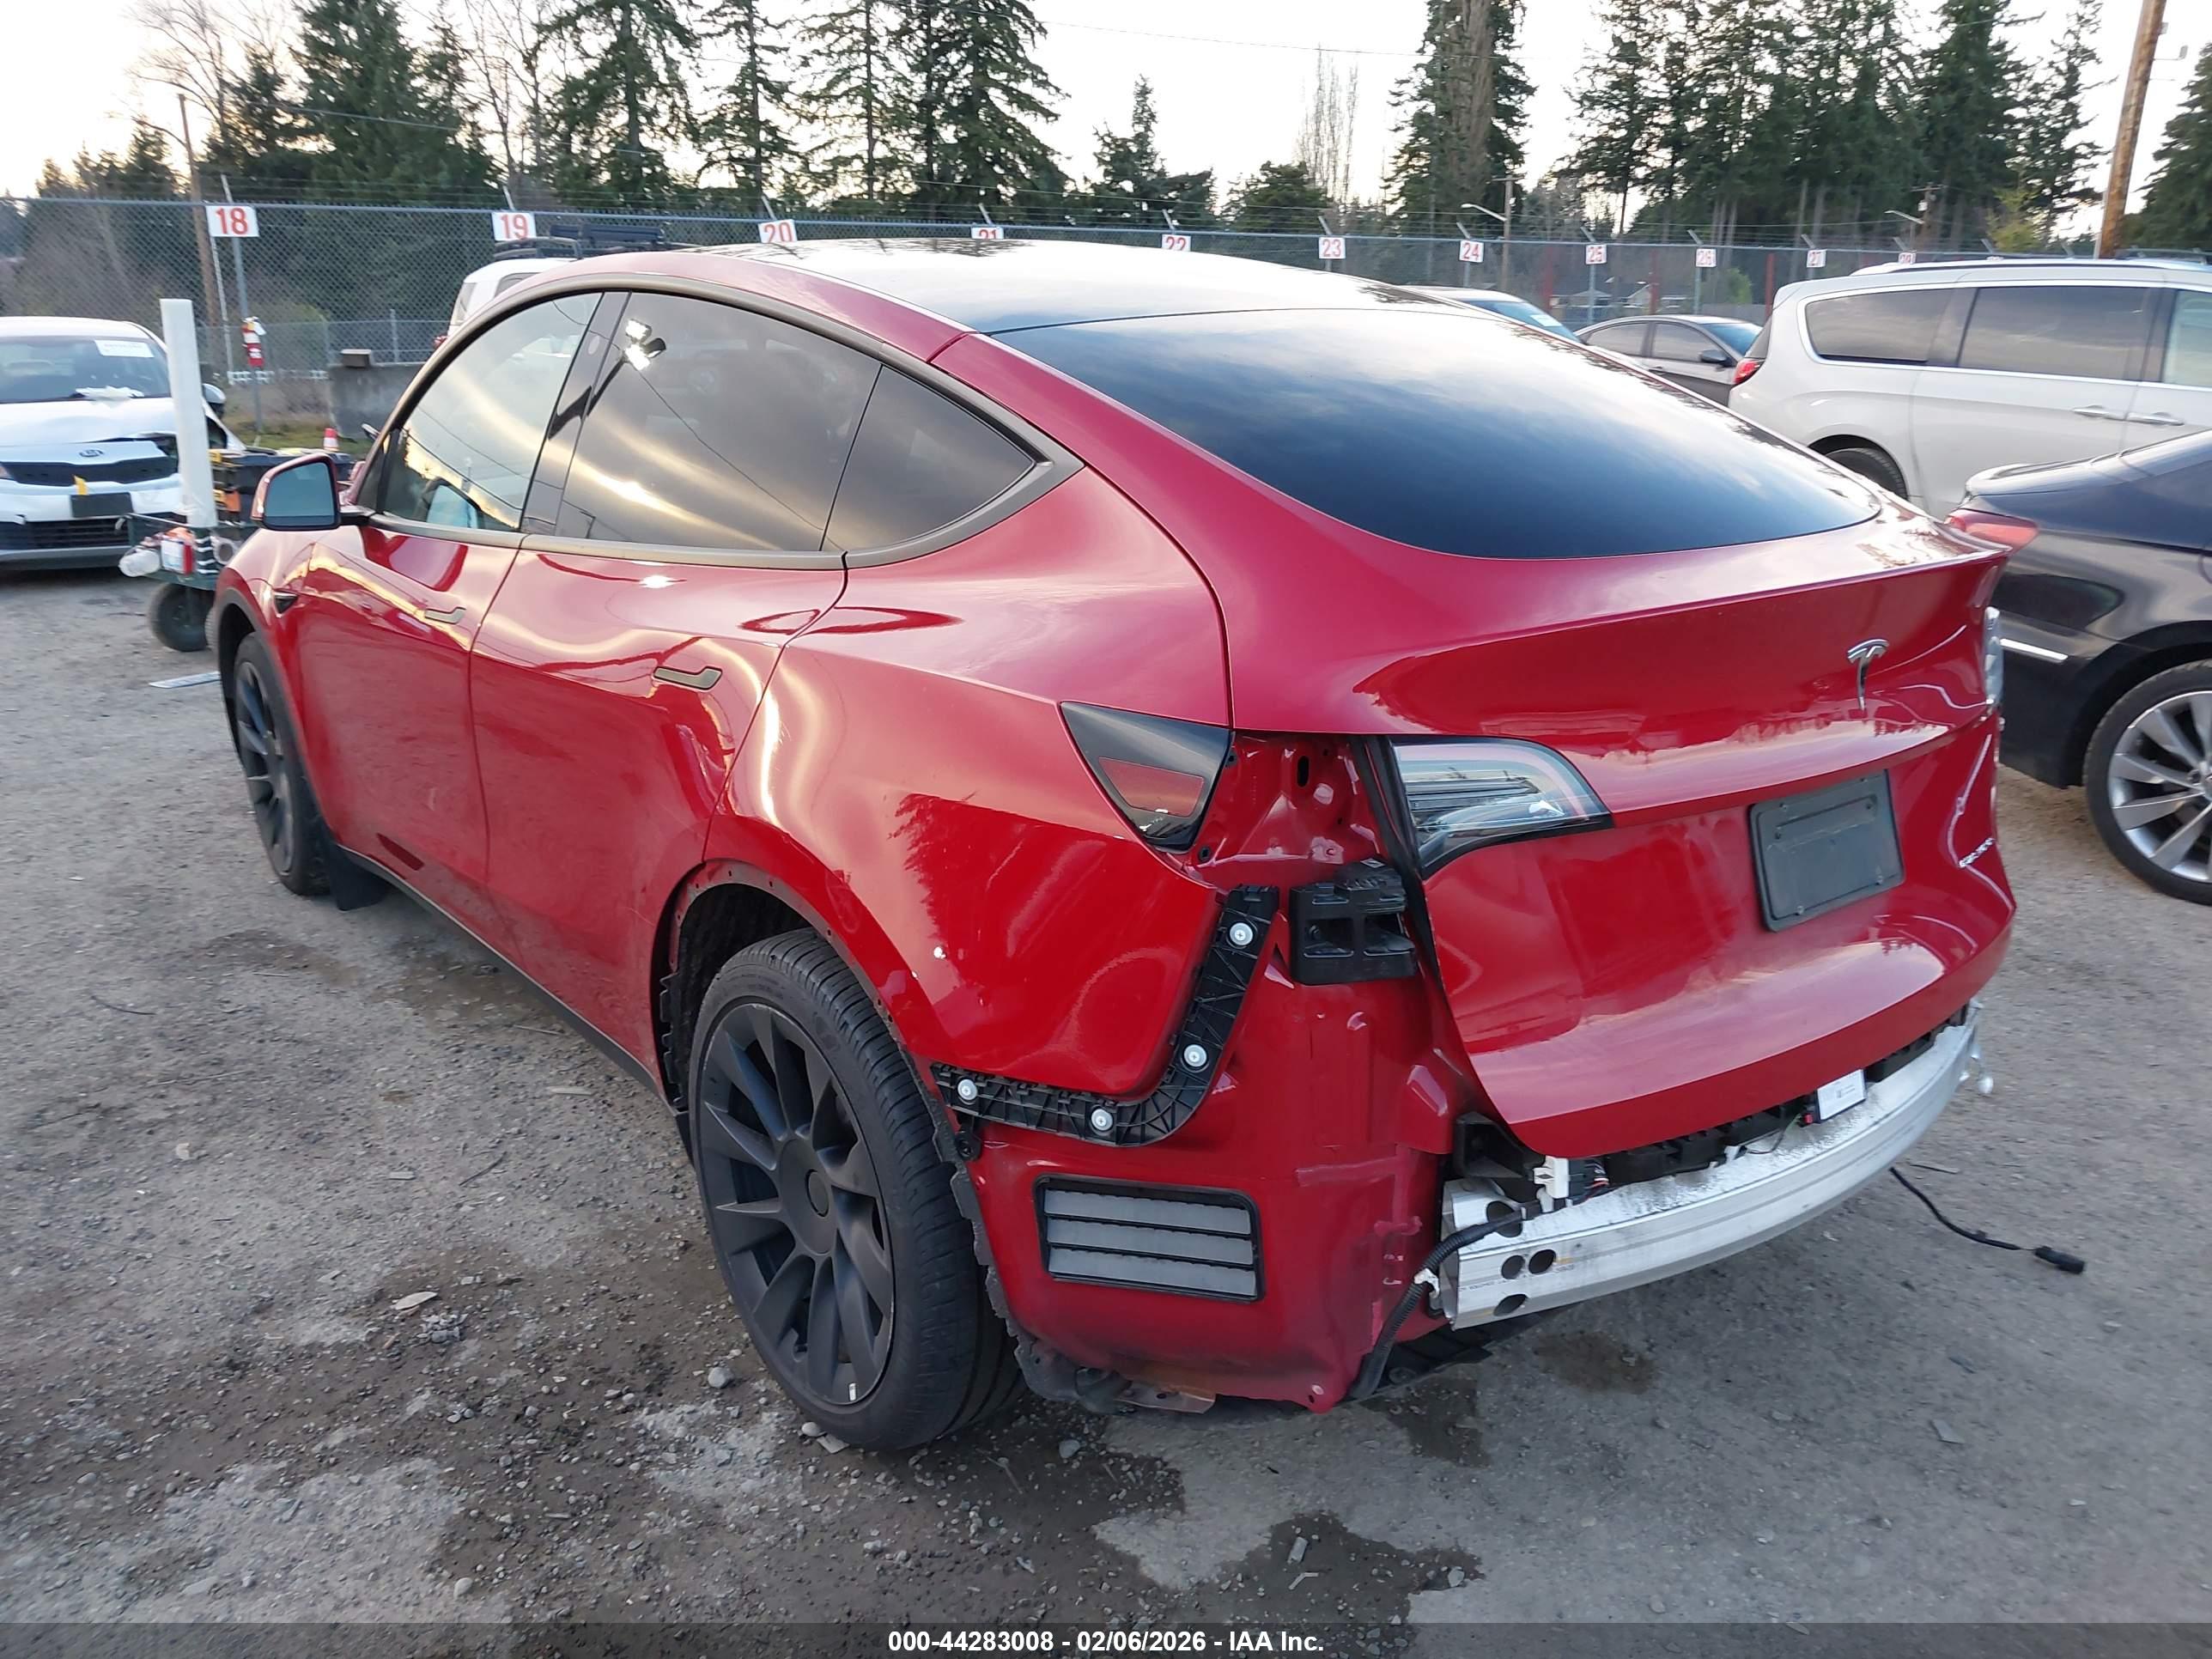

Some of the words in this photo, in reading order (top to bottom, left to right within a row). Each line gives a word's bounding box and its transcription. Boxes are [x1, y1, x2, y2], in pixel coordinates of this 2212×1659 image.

[216, 208, 248, 235] 18
[500, 214, 528, 240] 19
[763, 222, 793, 244] 20
[1166, 236, 1187, 251] 22
[1322, 239, 1341, 258] 23
[1462, 242, 1480, 261] 24
[1589, 246, 1602, 263] 25
